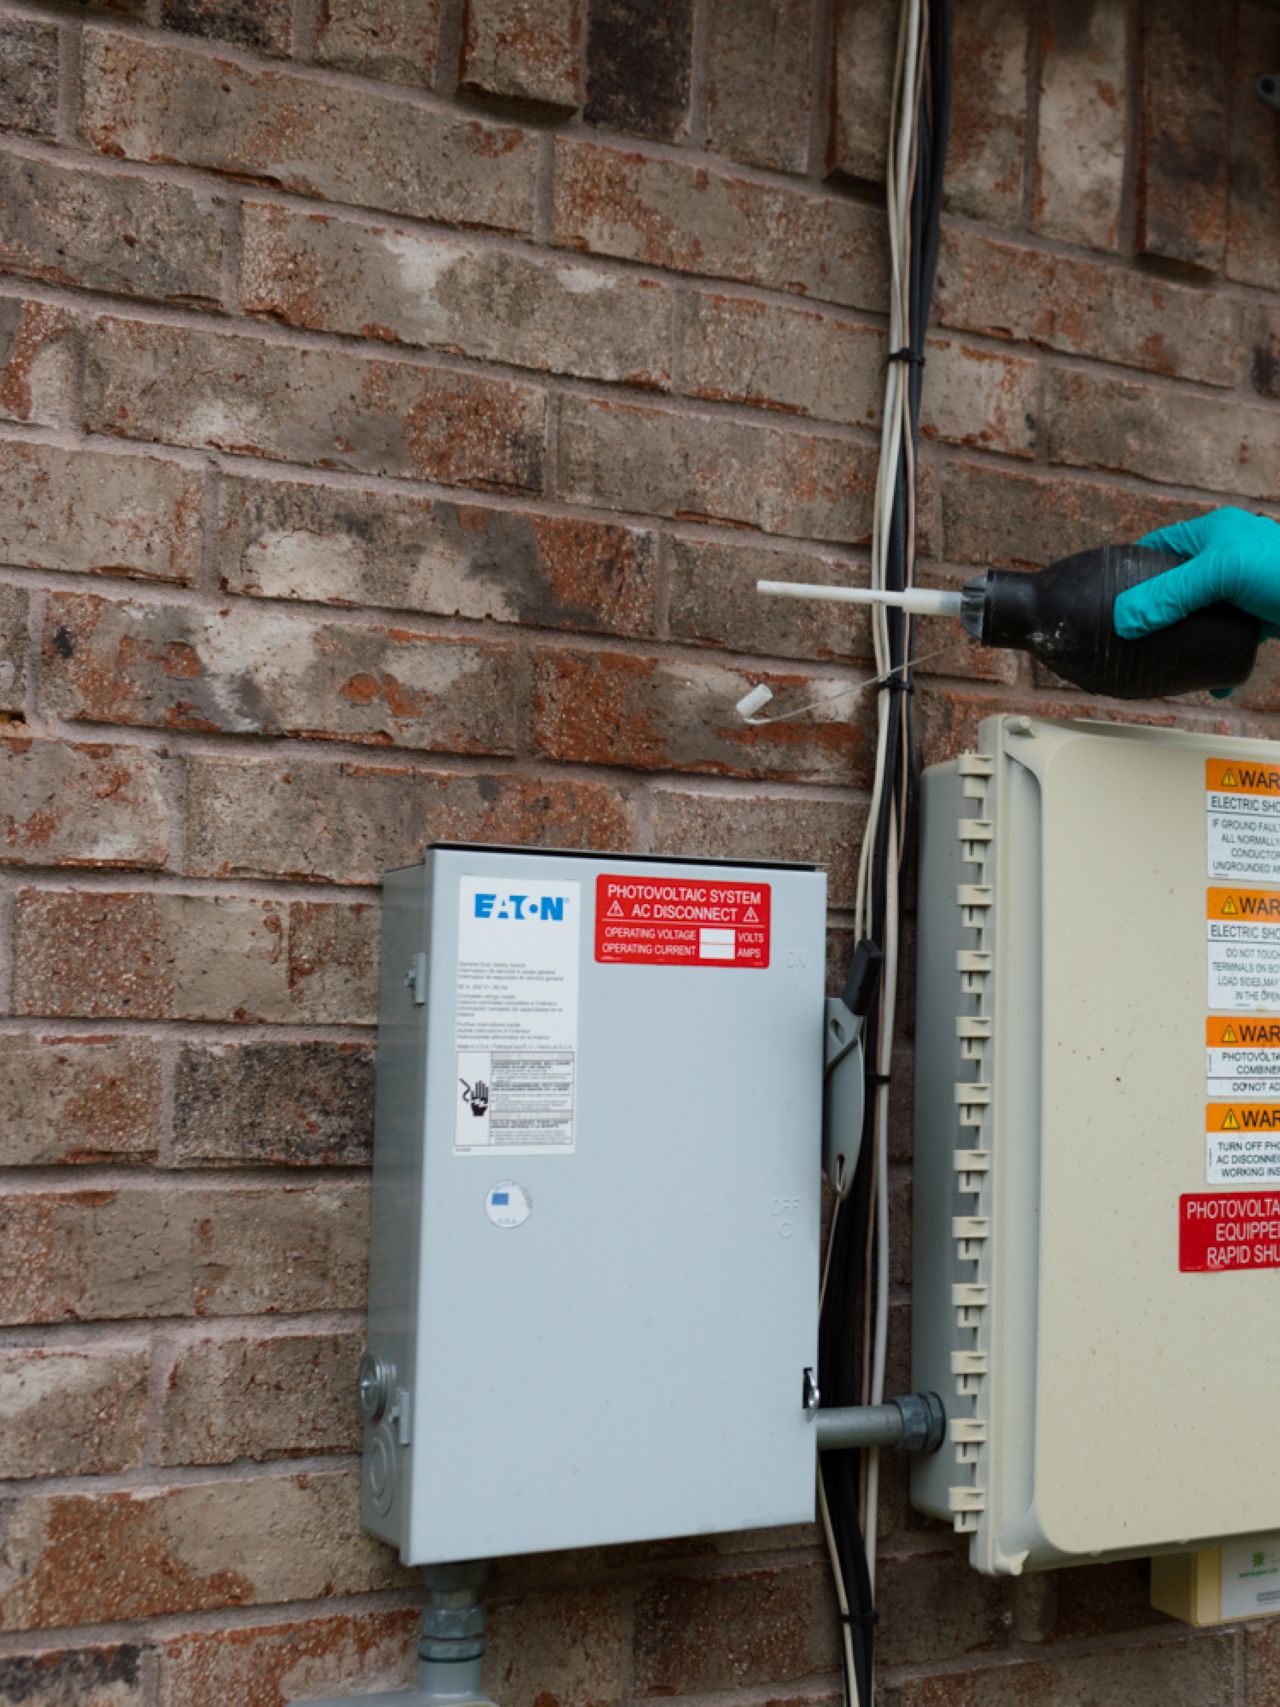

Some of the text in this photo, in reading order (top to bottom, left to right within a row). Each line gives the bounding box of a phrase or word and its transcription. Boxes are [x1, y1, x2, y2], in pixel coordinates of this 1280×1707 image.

[1211, 796, 1259, 811] ELECTRIC
[1212, 819, 1219, 828] IF
[1221, 819, 1257, 832] GROUND
[1221, 834, 1235, 843] ALL
[1238, 835, 1280, 846] NORMALLY
[1213, 862, 1271, 874] UNGROUNDED
[608, 884, 761, 904] PHOTOVOLTAIC SYSTEM
[632, 904, 737, 921] AC DISCONNECT
[605, 927, 763, 942] OPERATING VOLTAGE VOLTS
[1211, 925, 1259, 939] ELECTRIC
[602, 943, 761, 957] OPERATING CURRENT AMPS
[1226, 949, 1237, 958] DO
[1240, 949, 1254, 958] NOT
[1235, 991, 1243, 1000] IN
[1245, 992, 1259, 1001] THE
[1261, 992, 1280, 1001] OPEN
[1232, 1082, 1245, 1091] DO
[1248, 1082, 1266, 1091] NOT
[1218, 1142, 1242, 1151] TURN
[1245, 1142, 1262, 1150] OFF
[1217, 1155, 1229, 1164] AC
[1221, 1168, 1265, 1177] WORKING
[1208, 1245, 1250, 1265] RAPID
